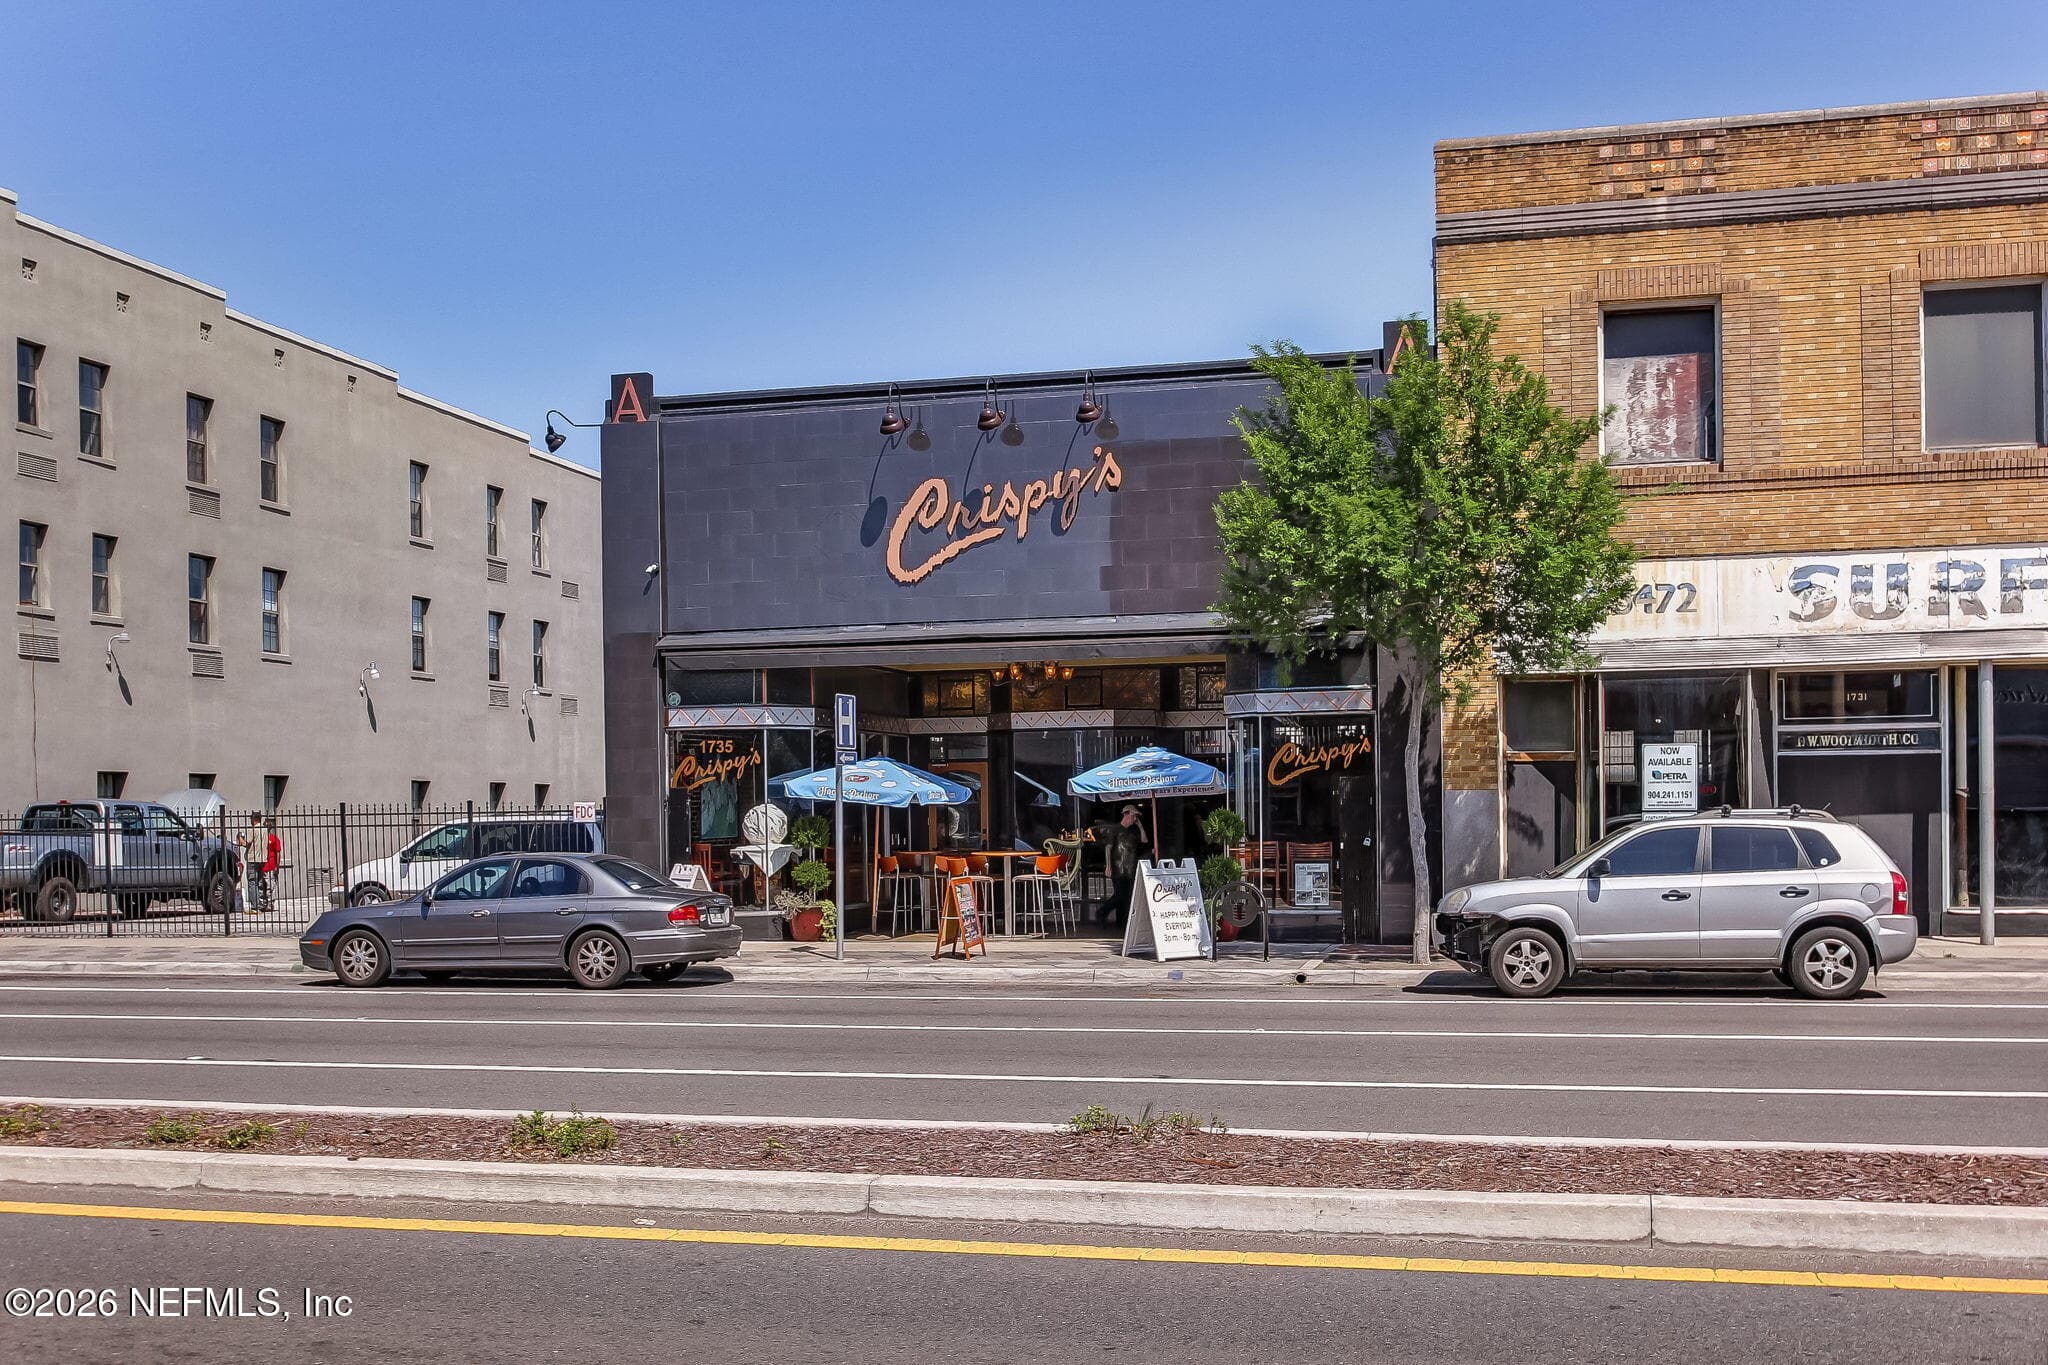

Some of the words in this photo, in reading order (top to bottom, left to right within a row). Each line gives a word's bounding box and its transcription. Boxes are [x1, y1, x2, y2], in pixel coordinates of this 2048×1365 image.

[887, 446, 1122, 584] Crispy's
[1846, 692, 1868, 702] 1731
[838, 697, 854, 746] H
[700, 740, 734, 754] 1735
[1660, 746, 1681, 755] NOW
[1267, 734, 1372, 786] Crispy's
[1648, 758, 1693, 767] AVAILABLE
[670, 746, 761, 792] Crispy's
[1662, 772, 1688, 780] PETRA
[816, 786, 880, 801] Hacr-Pschorr
[1647, 791, 1693, 799] 904.241.1151
[575, 805, 593, 819] FDC
[1160, 911, 1178, 919] HAPPY
[1165, 922, 1193, 931] EVERYDAY
